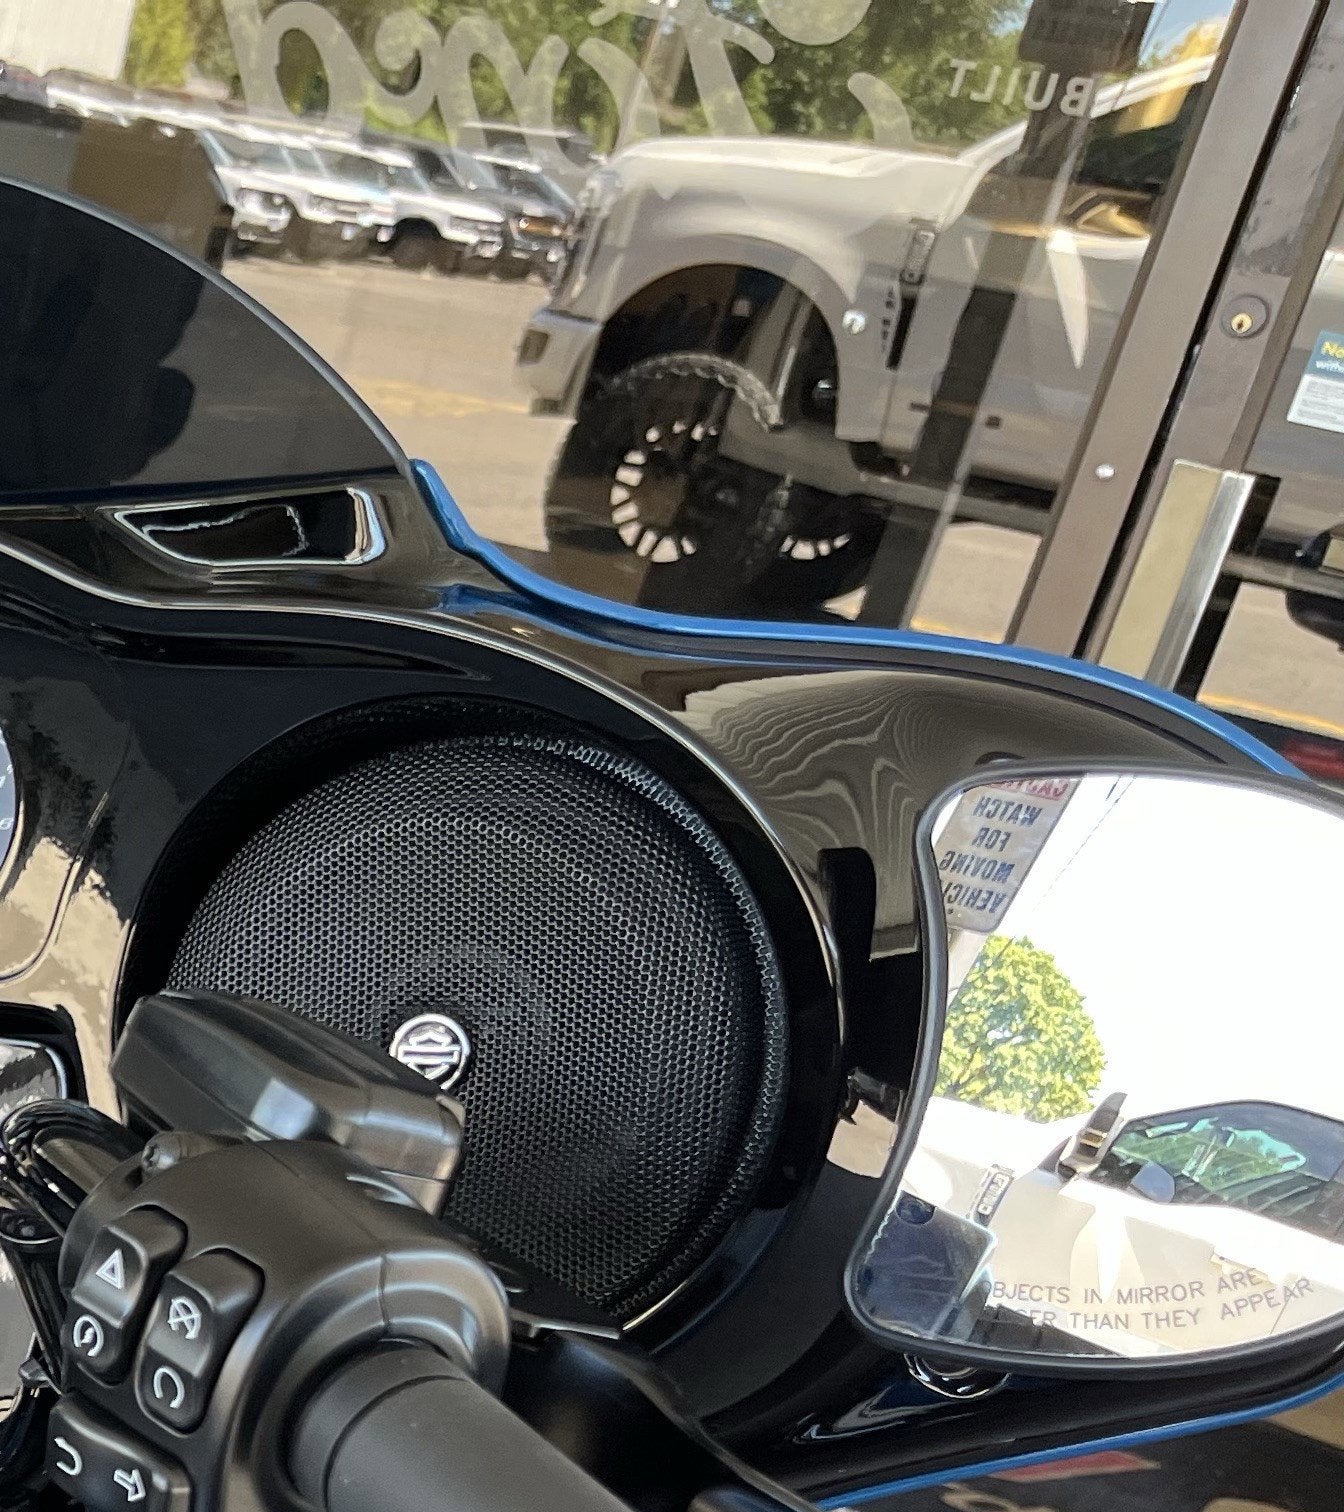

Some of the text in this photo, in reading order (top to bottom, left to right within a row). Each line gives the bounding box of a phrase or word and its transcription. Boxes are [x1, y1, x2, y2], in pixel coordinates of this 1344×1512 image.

[1070, 1312, 1130, 1330] THAN
[1140, 1307, 1201, 1331] THEY
[1219, 1276, 1315, 1320] APPEAR
[1084, 1288, 1103, 1304] IN
[1116, 1280, 1206, 1305] MIRROR
[1216, 1267, 1261, 1295] ARE
